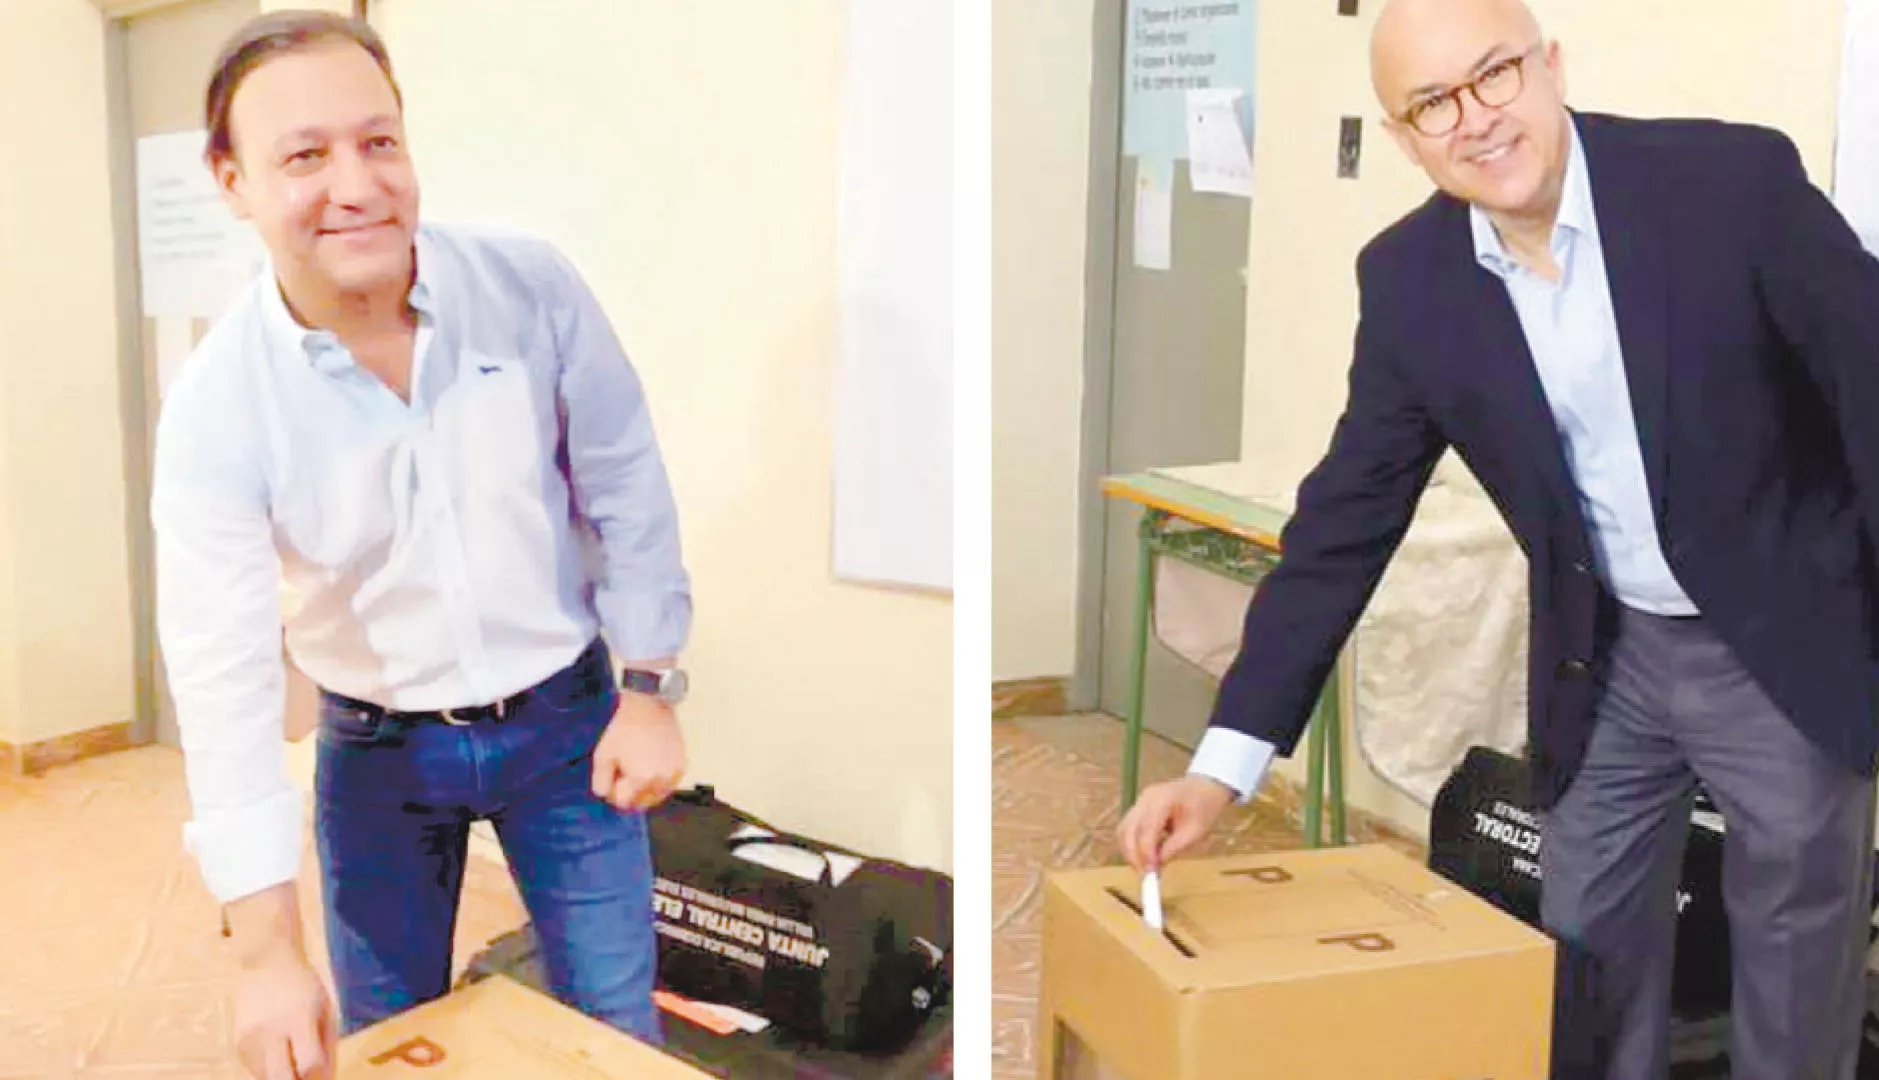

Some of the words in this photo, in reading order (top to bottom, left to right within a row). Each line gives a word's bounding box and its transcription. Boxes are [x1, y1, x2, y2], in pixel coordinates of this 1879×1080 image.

[1221, 866, 1293, 885] P
[687, 902, 765, 946] CENTRAL
[768, 928, 830, 968] JUNTA
[1316, 932, 1395, 953] P
[367, 1035, 446, 1068] P
